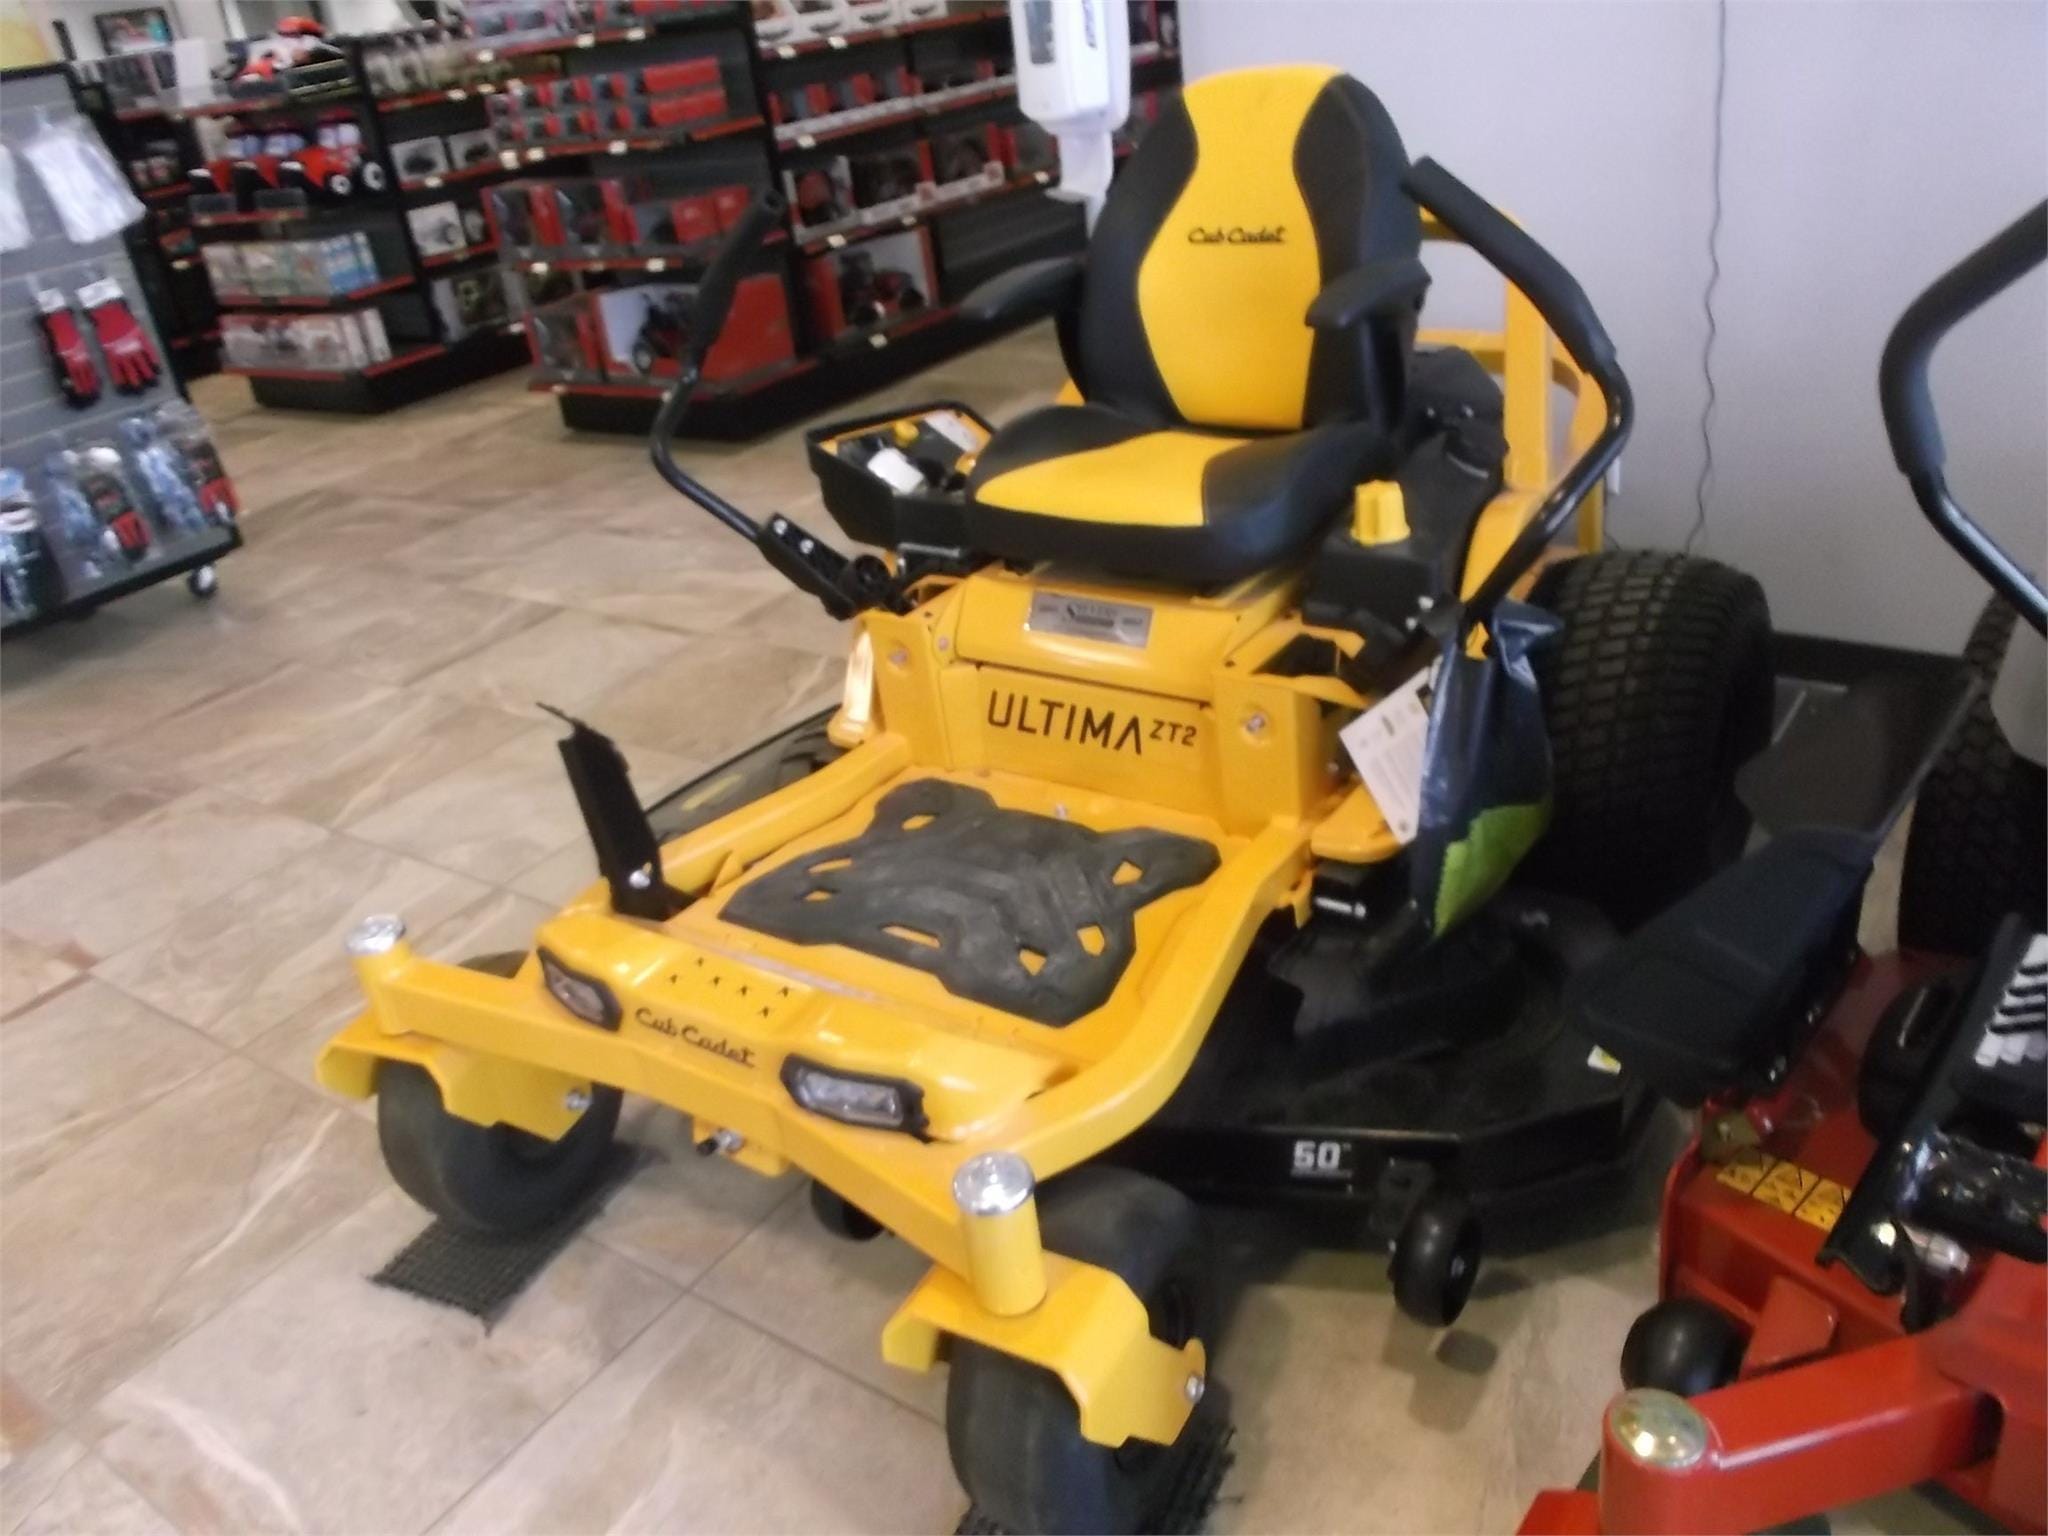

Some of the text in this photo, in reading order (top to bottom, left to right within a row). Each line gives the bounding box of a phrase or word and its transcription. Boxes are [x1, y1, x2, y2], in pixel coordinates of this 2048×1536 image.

[1188, 225, 1286, 244] Cub Cadet
[987, 689, 1197, 756] ULTIMA ZT2
[636, 1006, 756, 1069] Cub Cadet
